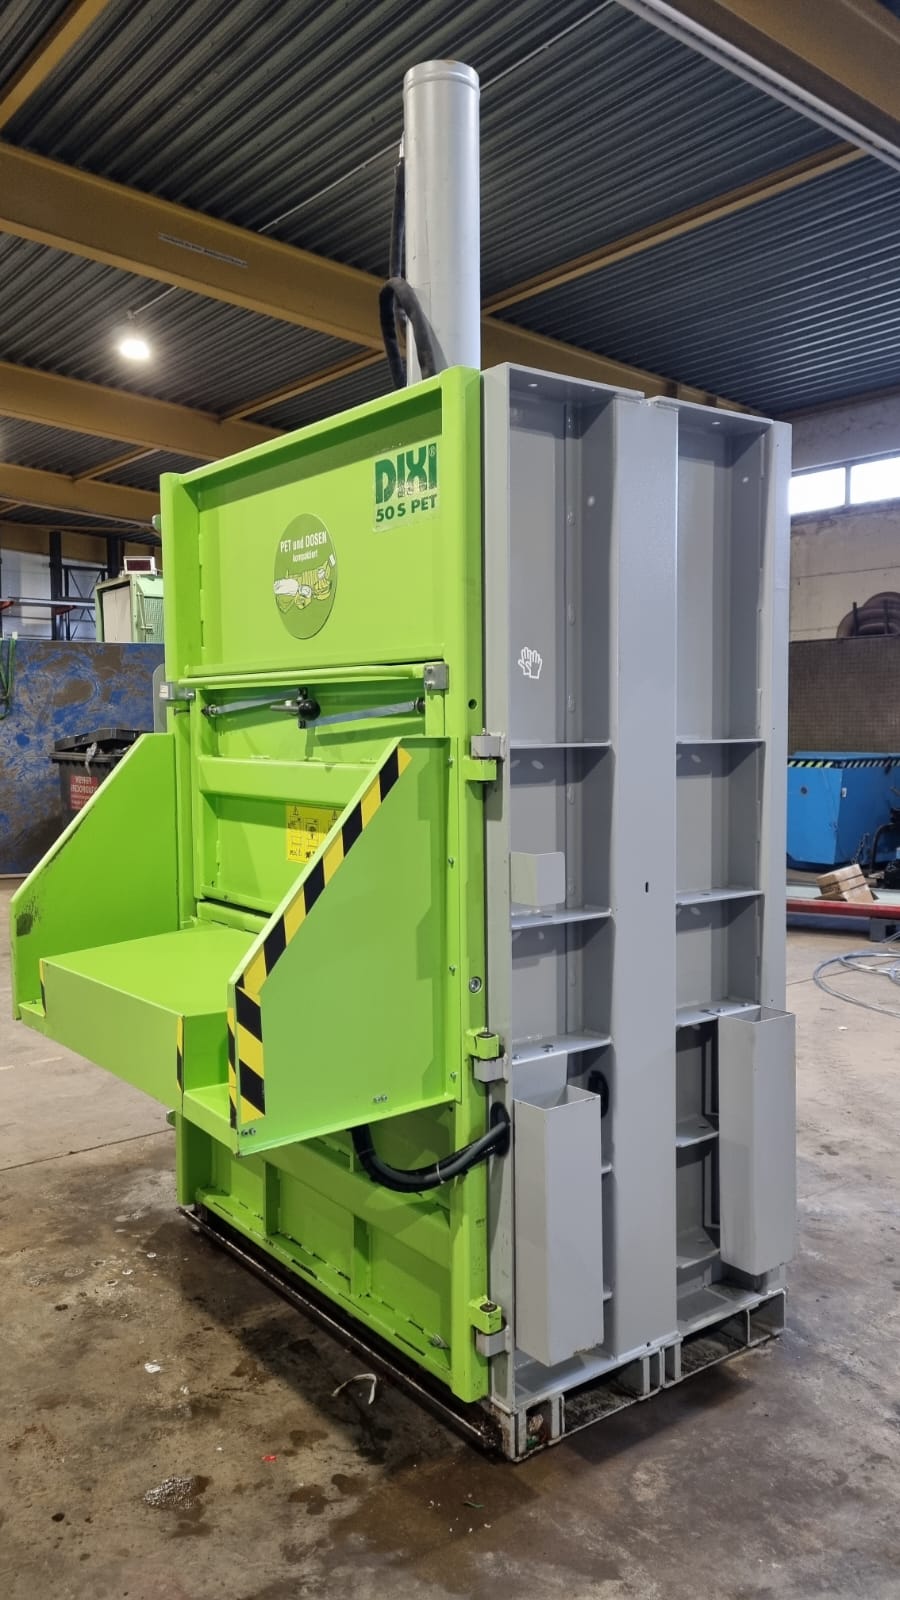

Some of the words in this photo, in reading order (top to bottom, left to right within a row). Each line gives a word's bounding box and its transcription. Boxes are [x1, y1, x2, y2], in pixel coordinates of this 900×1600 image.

[376, 506, 394, 522] 50
[411, 494, 437, 513] PET
[280, 540, 291, 553] PET
[293, 536, 304, 550] und
[305, 530, 327, 548] DOSEN
